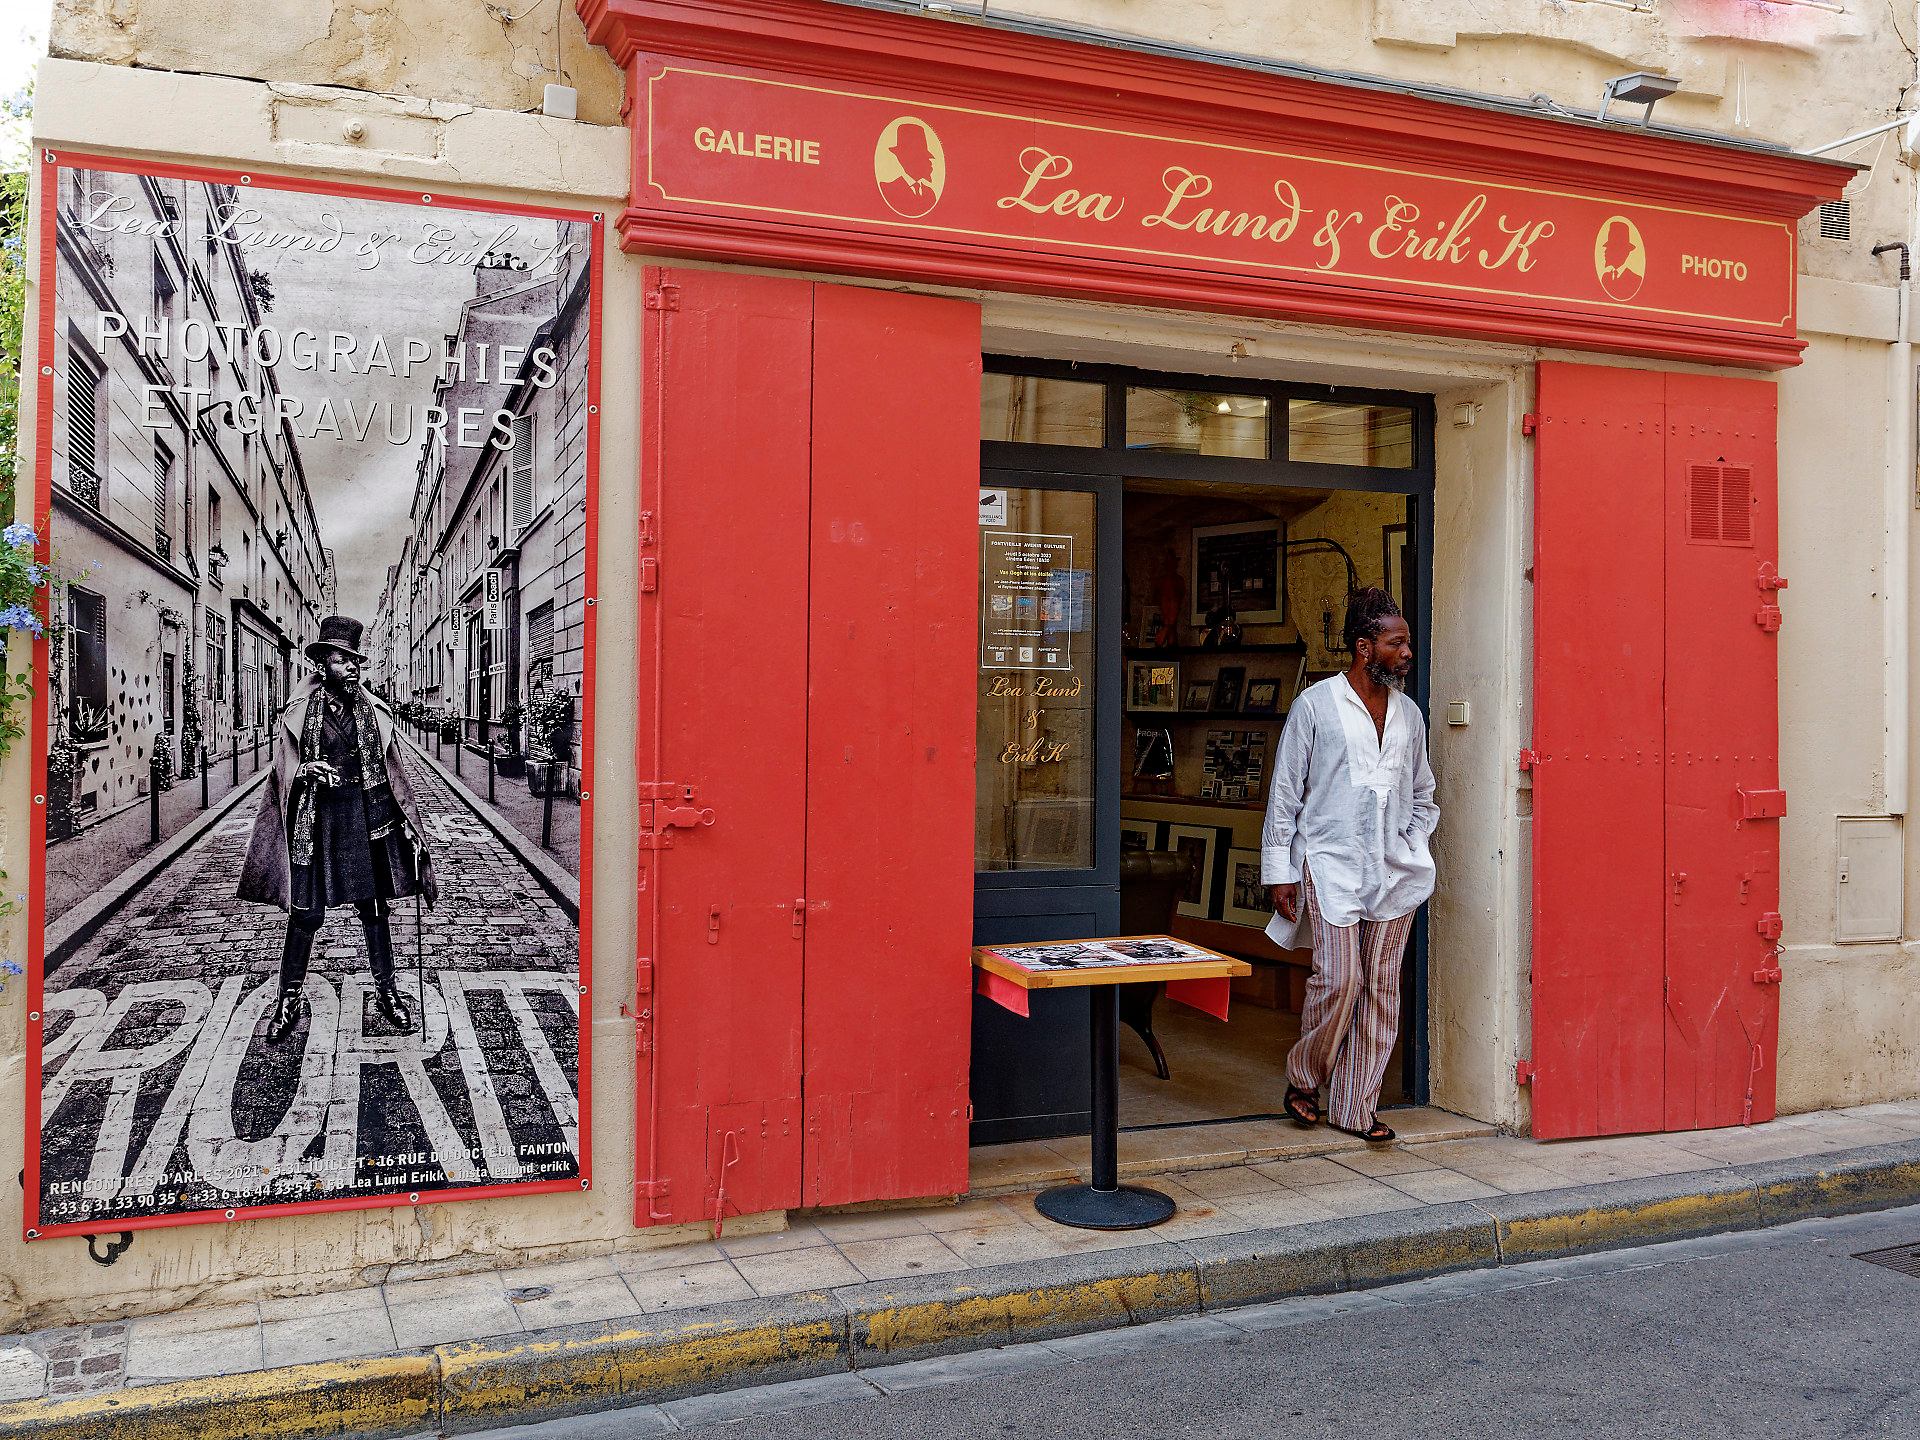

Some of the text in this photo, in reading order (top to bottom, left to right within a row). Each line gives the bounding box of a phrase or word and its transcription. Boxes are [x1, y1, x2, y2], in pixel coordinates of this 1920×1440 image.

[694, 127, 821, 165] GALERIE
[67, 190, 583, 275] Lea Lund & Erik K
[996, 146, 1556, 273] Lea Lund & Erik K
[1682, 254, 1749, 283] PHOTO
[97, 310, 558, 390] PHOTOGRAPHIES
[141, 385, 518, 452] ET GRAVURES
[488, 573, 499, 625] Paris Coach
[986, 676, 1085, 696] Lea Lund
[1027, 710, 1045, 729] &
[1001, 737, 1070, 763] Erik K
[50, 1176, 154, 1194] RENCONTRES
[160, 1169, 222, 1186] D'ARLES
[226, 1166, 258, 1180] 2021
[305, 1157, 366, 1173] JUILLET
[380, 1155, 393, 1168] 16
[399, 1152, 425, 1165] RUE
[430, 1150, 449, 1162] DU
[452, 1146, 515, 1162] DOCTEUR
[520, 1142, 570, 1156] FANTON
[50, 1201, 76, 1215] +33
[81, 1200, 89, 1213] 6
[93, 1198, 110, 1211] 31
[116, 1196, 133, 1209] 33
[138, 1194, 154, 1207] 90
[159, 1193, 175, 1206] 35
[193, 1187, 217, 1202] +33
[222, 1185, 229, 1198] 6
[235, 1184, 250, 1198] 18
[255, 1183, 270, 1196] 44
[275, 1181, 290, 1194] 33
[295, 1180, 311, 1193] 54
[327, 1177, 344, 1190] FB
[351, 1173, 371, 1188] Lea
[376, 1170, 407, 1186] Lund
[412, 1169, 444, 1182] Erikk
[459, 1166, 487, 1179] insta
